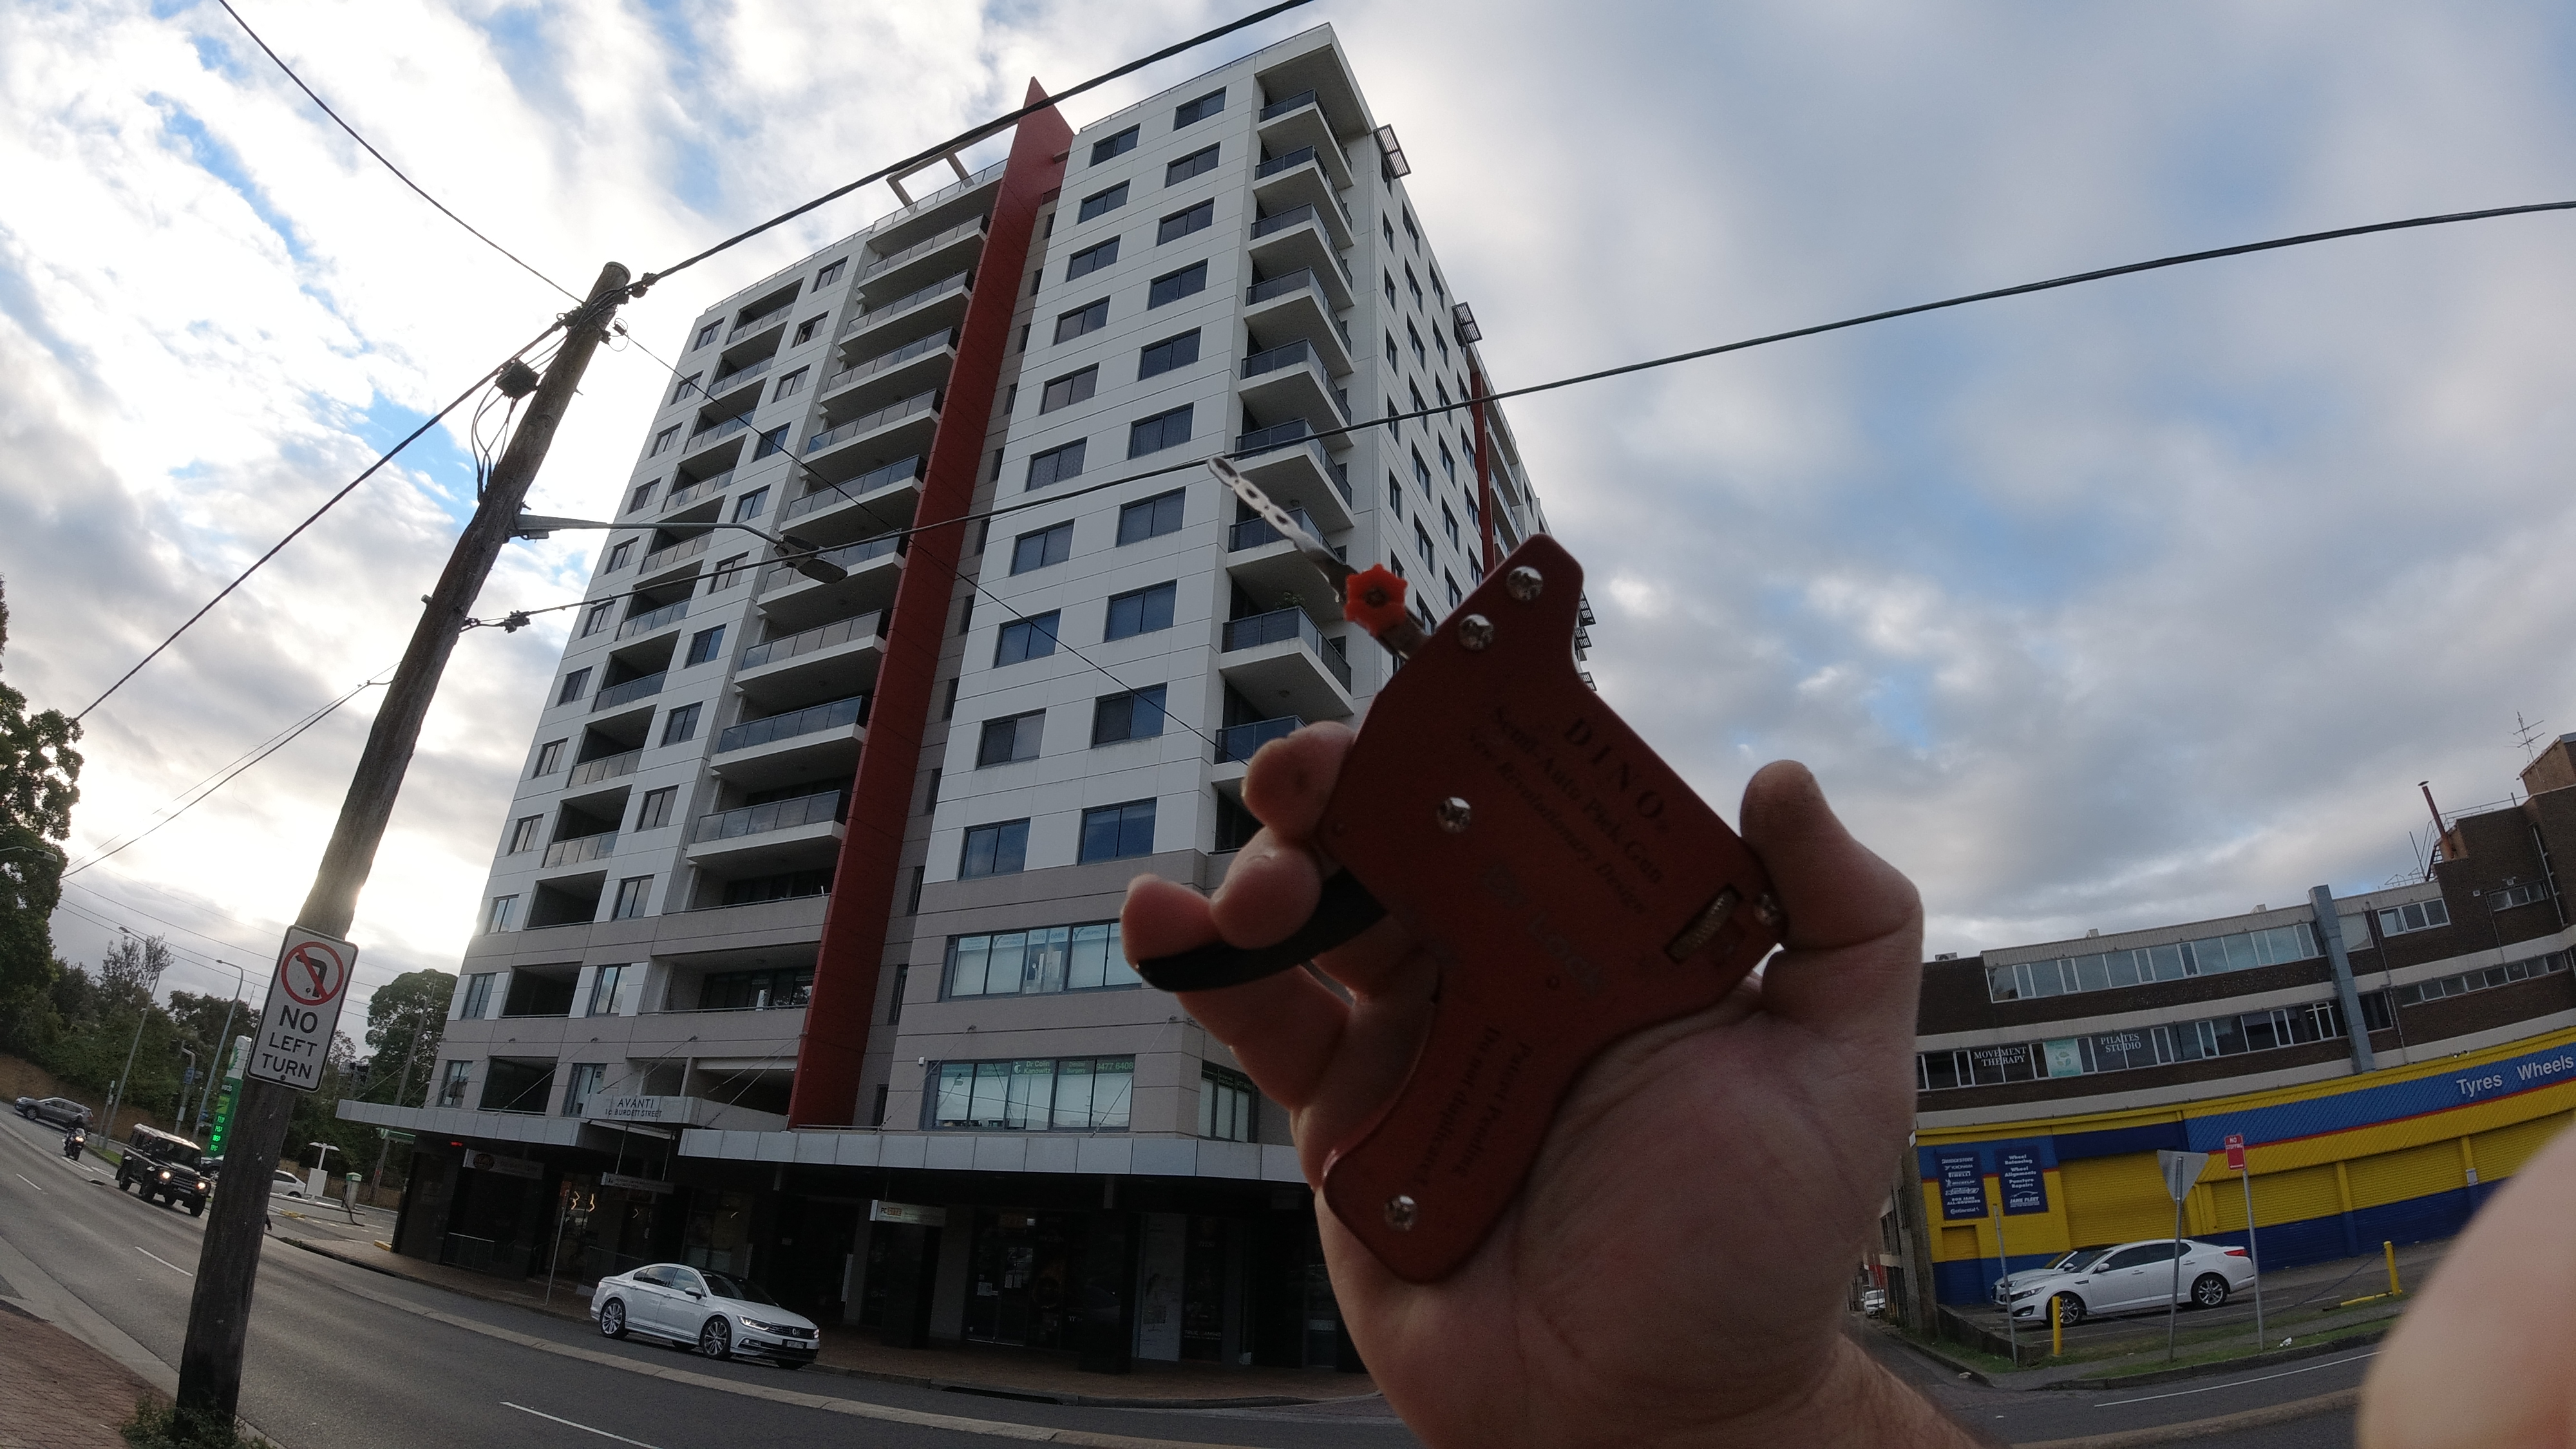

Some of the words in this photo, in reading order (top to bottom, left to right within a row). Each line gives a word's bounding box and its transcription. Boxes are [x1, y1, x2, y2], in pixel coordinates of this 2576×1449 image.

[279, 1005, 318, 1034] NO
[269, 1032, 317, 1057] LEFT
[2101, 1033, 2139, 1045] PILATES
[1974, 1046, 2027, 1059] MOVEMENT
[2105, 1041, 2142, 1053] STUDIO
[262, 1053, 312, 1079] TURN
[1981, 1055, 2026, 1067] THERAPY
[2456, 1074, 2503, 1097] Tyres
[2516, 1055, 2574, 1081] Wheels
[617, 1099, 654, 1108] AVANTI
